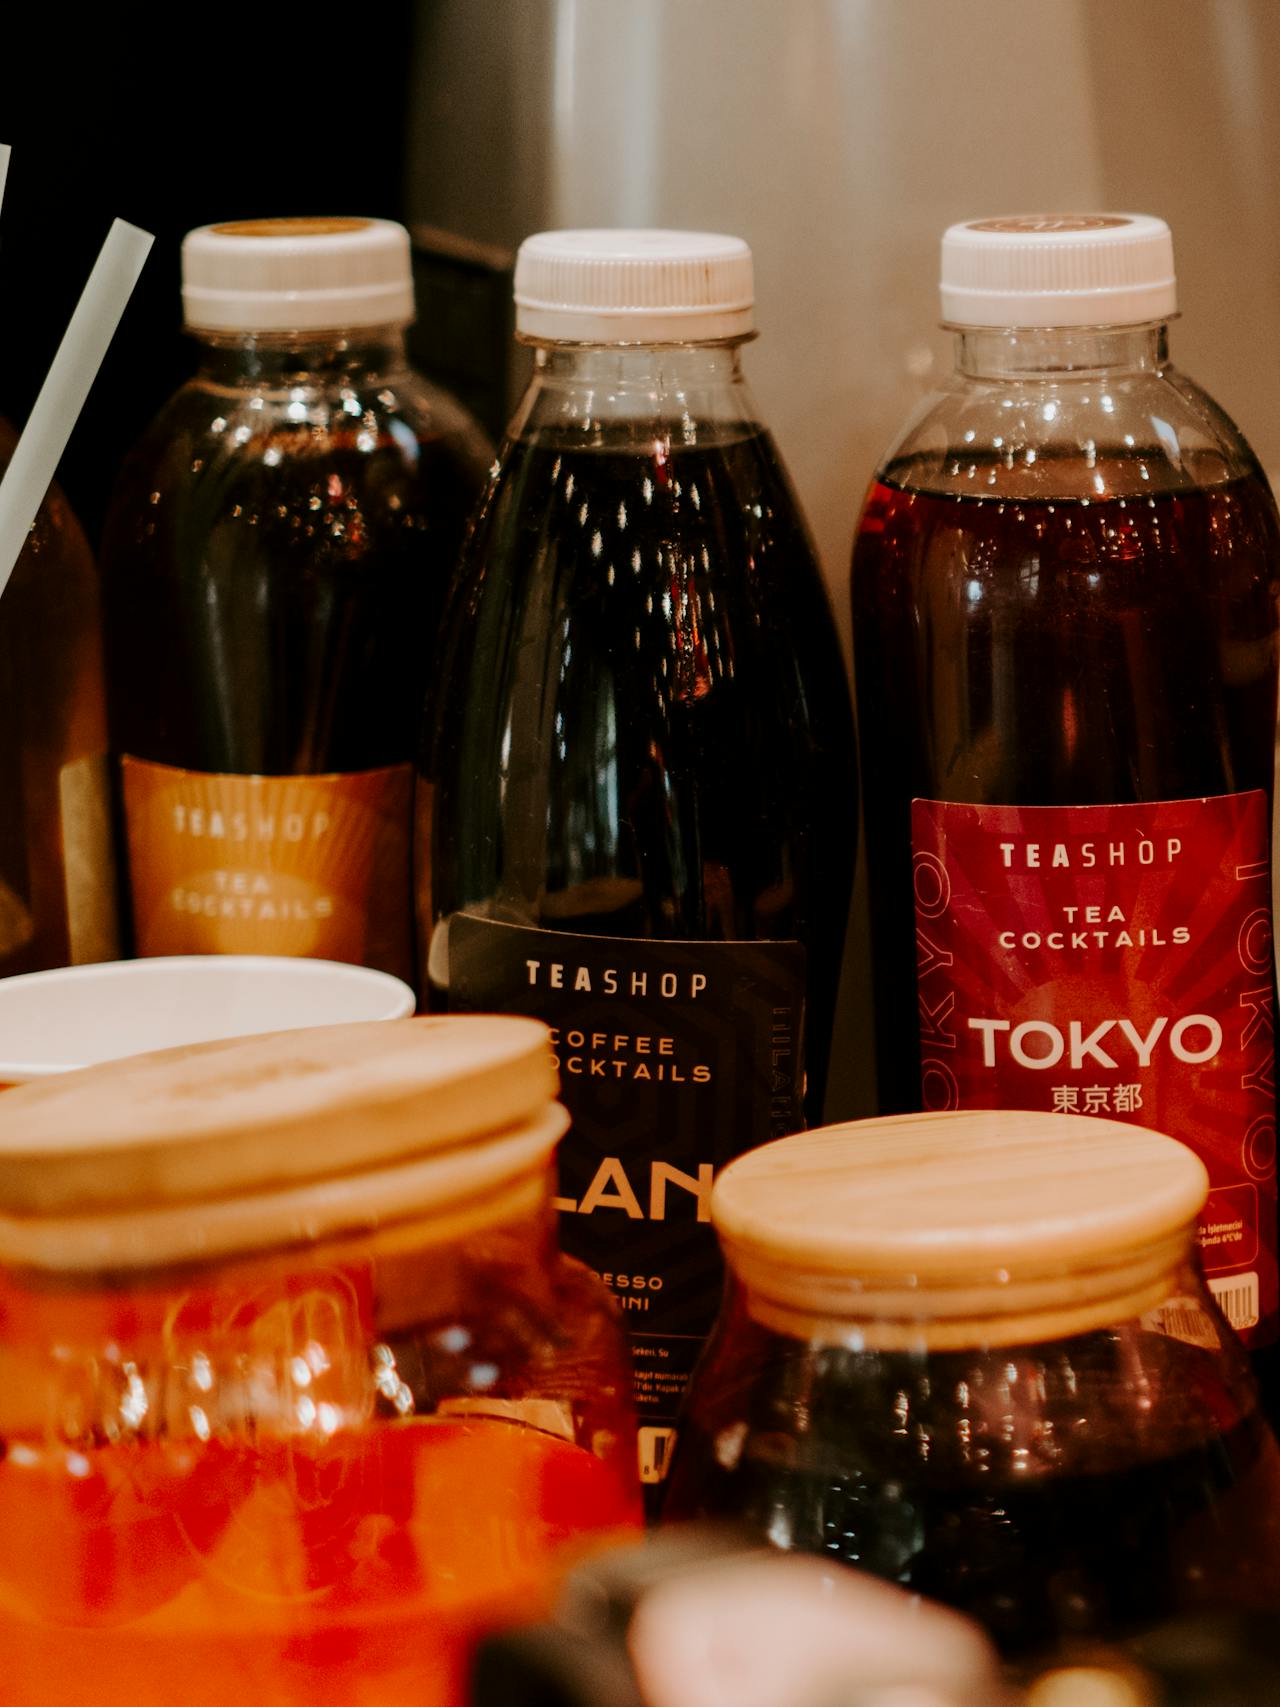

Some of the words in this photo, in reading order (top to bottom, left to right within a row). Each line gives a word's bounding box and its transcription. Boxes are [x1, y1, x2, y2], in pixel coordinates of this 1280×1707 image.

[172, 805, 331, 840] TEASHOP
[1000, 838, 1182, 868] TEASHOP
[214, 870, 270, 896] TEA
[170, 888, 333, 920] COCKTAILS
[1063, 905, 1126, 924] TEA
[998, 926, 1191, 950] COCKTAILS
[526, 960, 708, 999] TEASHOP
[547, 1027, 675, 1055] COFFEE
[968, 1014, 1223, 1070] TOKYO
[1051, 1083, 1143, 1114] 東京都
